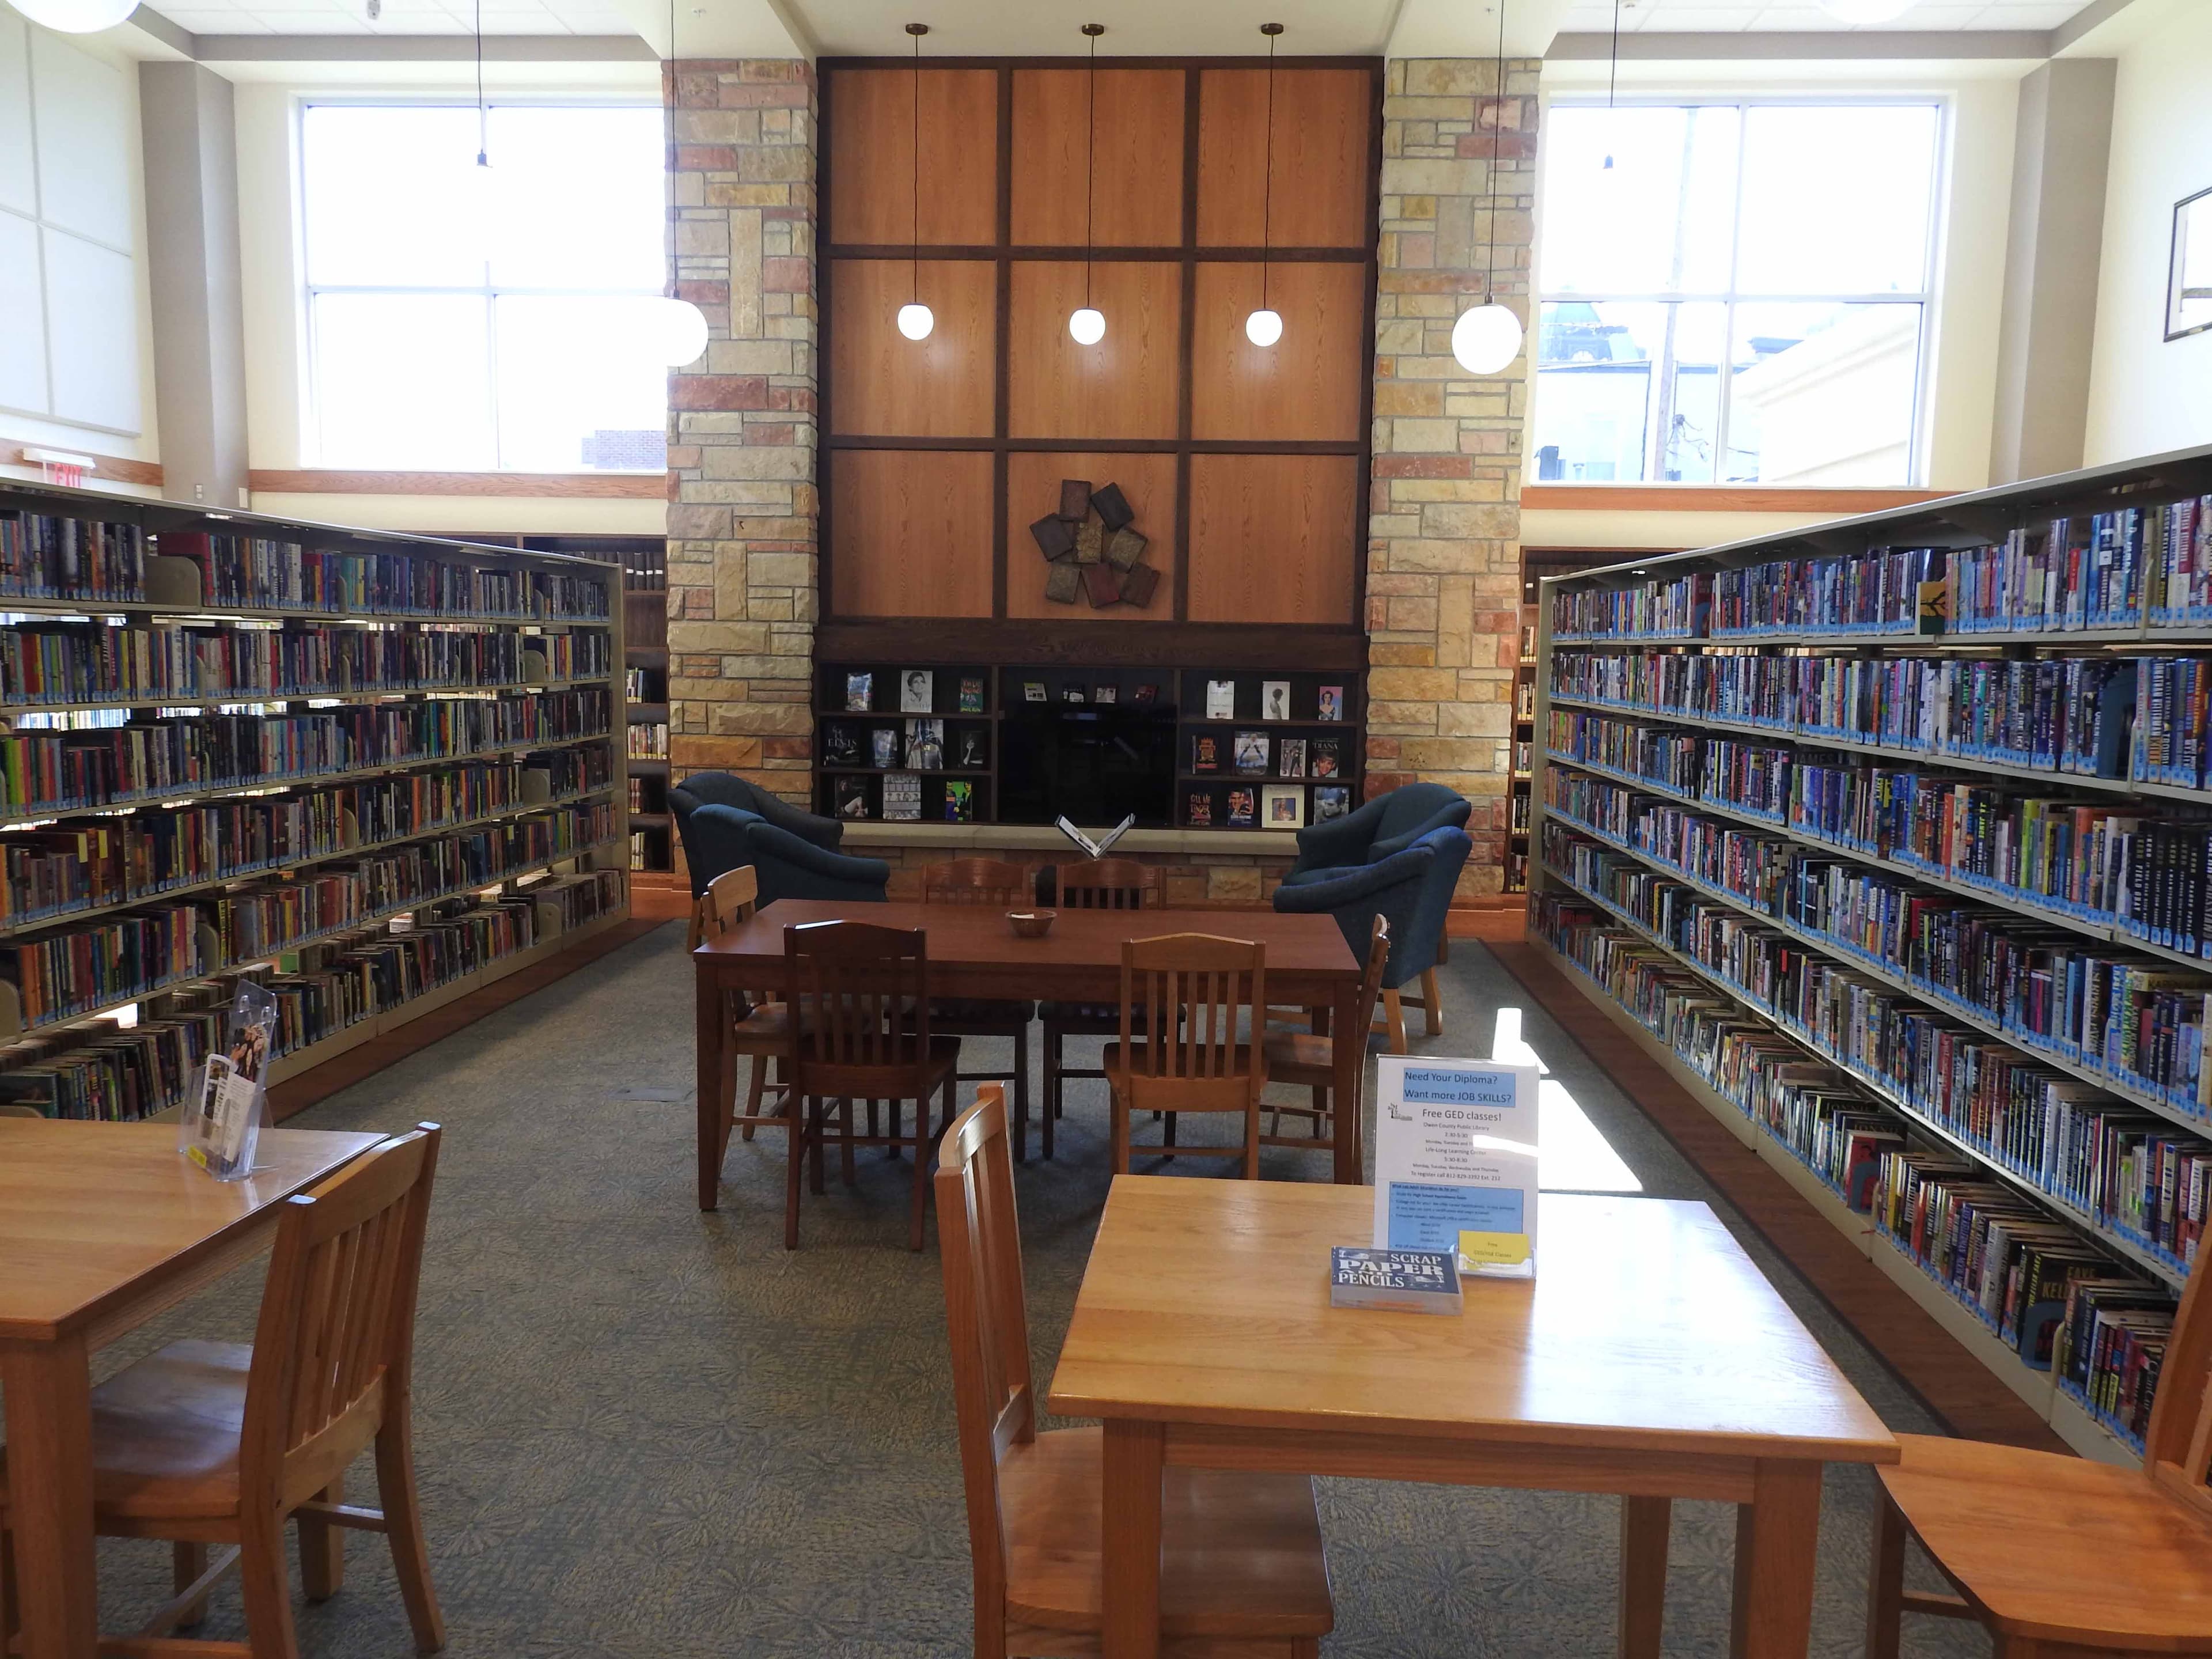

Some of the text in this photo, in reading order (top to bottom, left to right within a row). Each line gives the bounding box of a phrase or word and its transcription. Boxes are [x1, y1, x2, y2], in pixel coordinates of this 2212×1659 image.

[55, 463, 83, 488] EXIT
[2160, 532, 2169, 578] KELLERMAN
[2071, 664, 2080, 697] PARADISE
[2152, 663, 2164, 696] JONATHAN
[2152, 699, 2162, 736] KELLERMAN
[2135, 865, 2143, 888] FIELD
[2134, 892, 2142, 911] GRAY
[1406, 1072, 1497, 1085] Need Your Diploma?
[1404, 1089, 1429, 1098] Want
[1457, 1092, 1475, 1101] JOB
[1478, 1093, 1512, 1103] SKILLS?
[1423, 1109, 1501, 1121] Free GED classes!
[1339, 1259, 1444, 1275] PAPER
[1391, 1253, 1441, 1264] SCRAP
[1338, 1273, 1405, 1287] PENCILS
